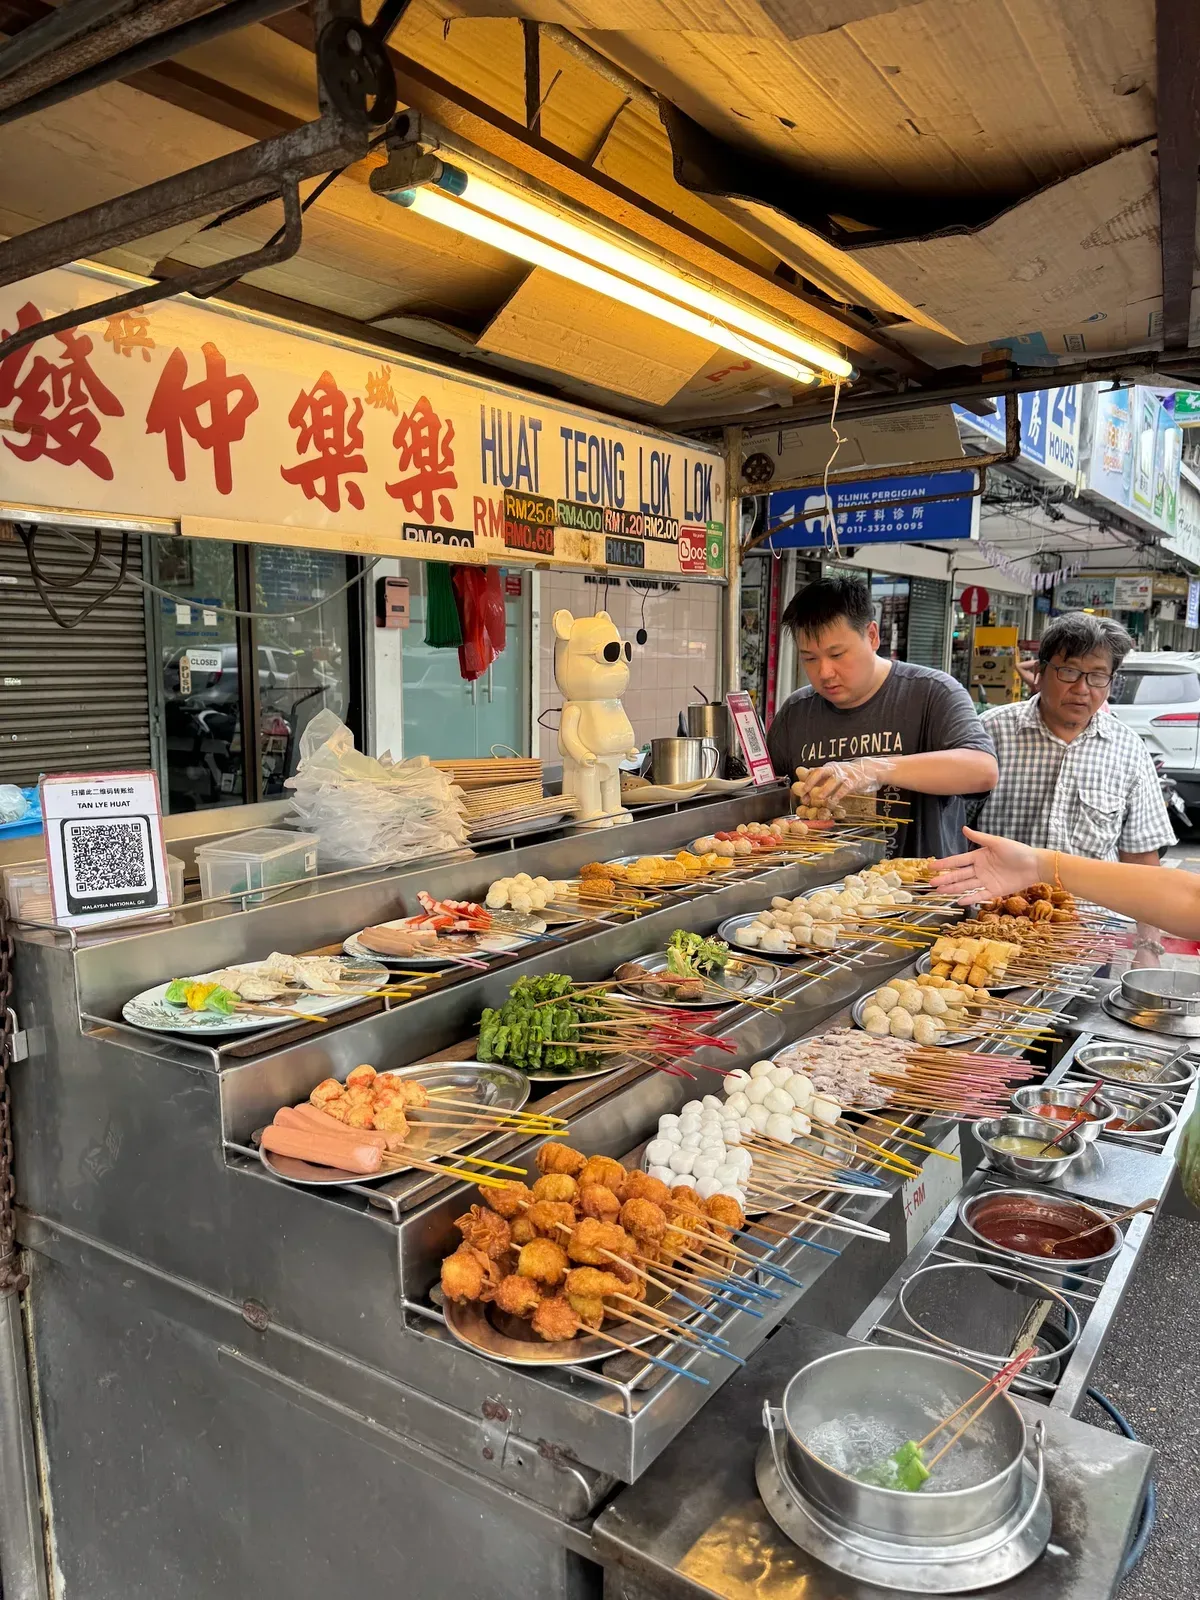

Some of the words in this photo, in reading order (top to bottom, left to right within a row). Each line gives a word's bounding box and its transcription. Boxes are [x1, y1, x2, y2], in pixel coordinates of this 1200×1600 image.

[1048, 431, 1075, 470] HOURS
[480, 404, 543, 493] HUAT
[560, 426, 626, 509] TEONG
[639, 446, 673, 517] LOK
[684, 458, 713, 524] LOK
[838, 491, 870, 502] KLINIK
[872, 488, 926, 499] PERGIGIAN
[557, 502, 602, 531] RM4.00
[604, 509, 643, 536] RM1.20
[644, 516, 678, 541] RM2.00
[846, 523, 893, 534] 011-3320
[896, 521, 924, 531] 0095
[504, 521, 554, 552] RM0.60
[606, 540, 643, 564] RM1.50
[190, 657, 218, 666] CLOSED
[181, 665, 190, 693] PUSH
[801, 731, 903, 762] CALIFORNIA
[71, 786, 135, 797] 扫描此二维码转账给
[81, 902, 109, 910] MALAYSIA
